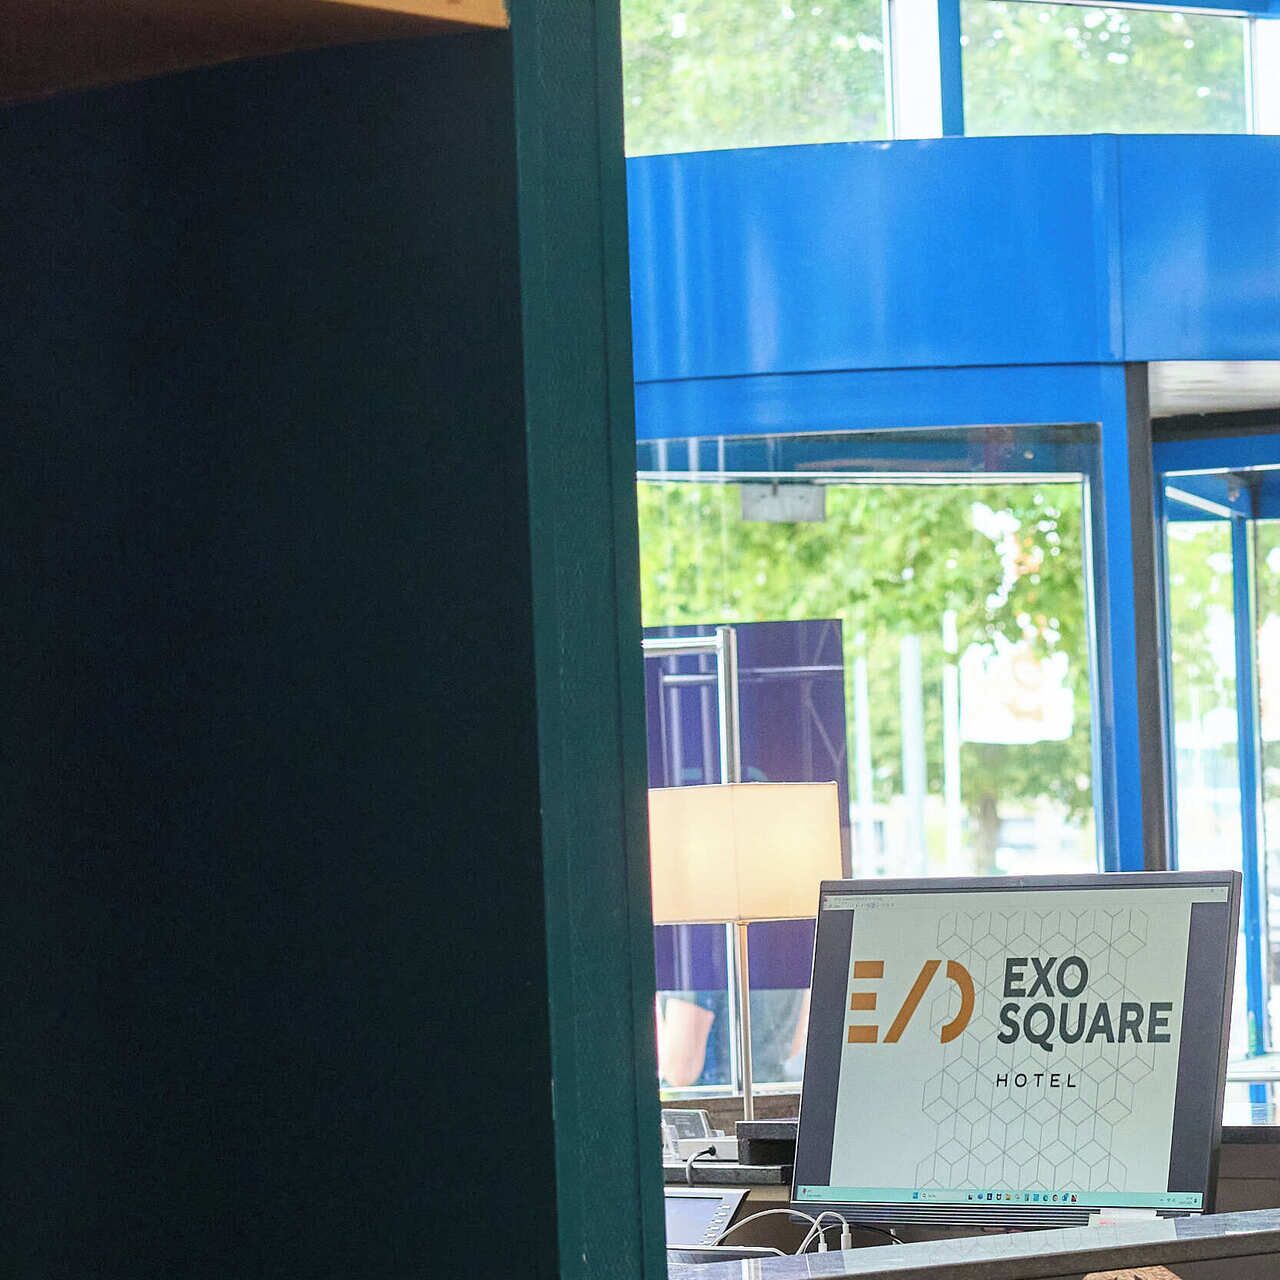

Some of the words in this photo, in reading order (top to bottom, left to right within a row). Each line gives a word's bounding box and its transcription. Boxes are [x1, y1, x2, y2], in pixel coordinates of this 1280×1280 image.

[1003, 955, 1089, 998] EXO
[996, 1001, 1173, 1052] SQUARE
[996, 1073, 1078, 1089] HOTEL
